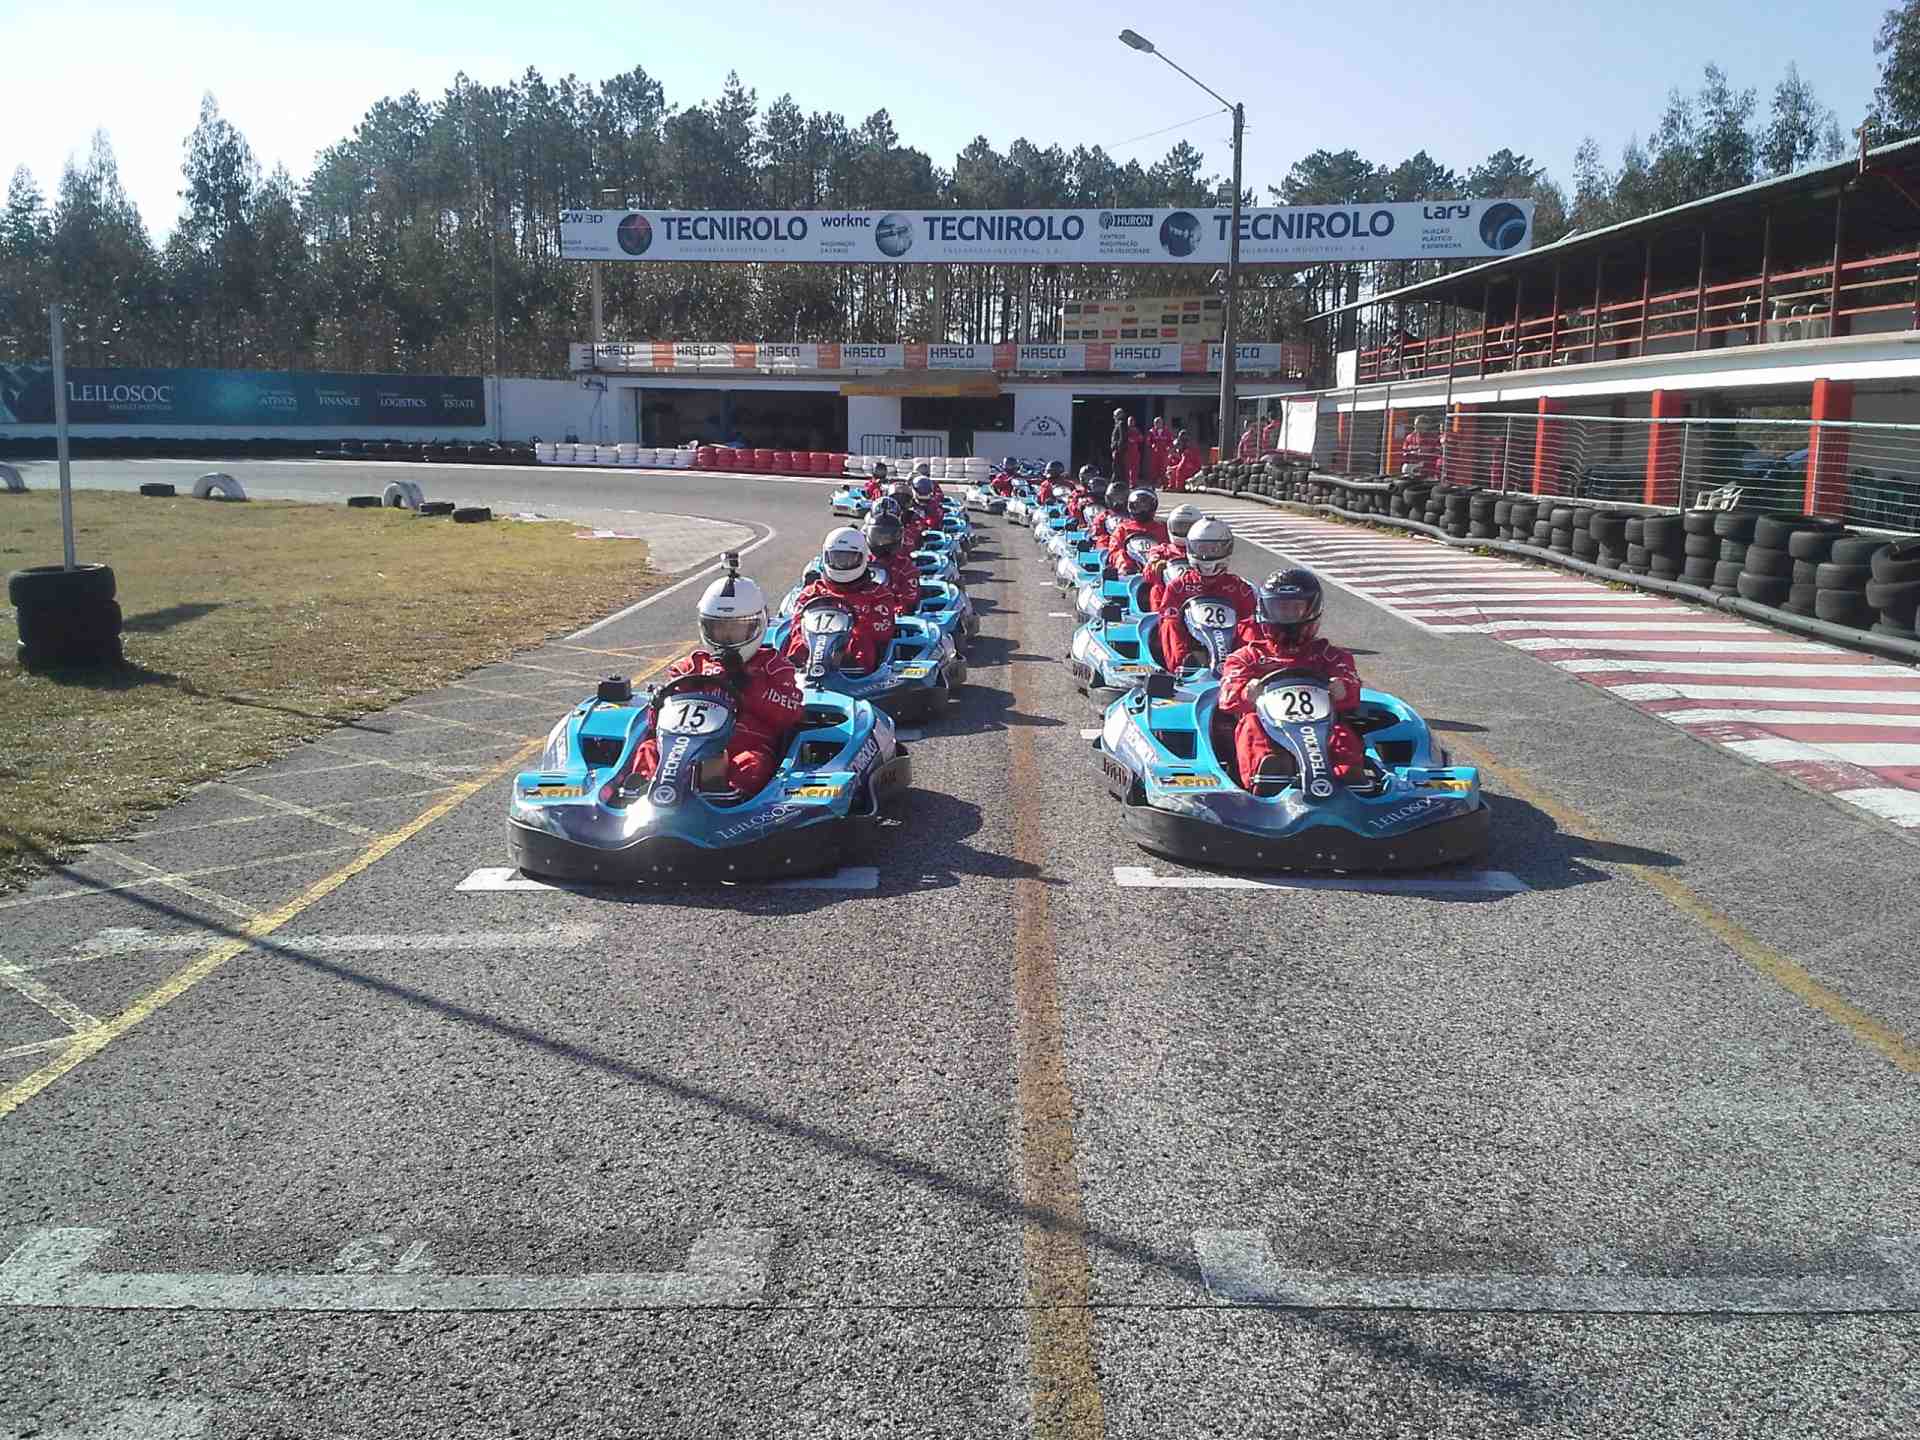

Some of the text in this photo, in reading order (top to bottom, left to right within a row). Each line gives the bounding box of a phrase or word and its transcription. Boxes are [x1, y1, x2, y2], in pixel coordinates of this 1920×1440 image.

[820, 213, 871, 228] worknc
[1116, 215, 1151, 226] HURON
[1213, 210, 1395, 241] TECNIROLO
[660, 216, 808, 241] TECNIROLO
[922, 215, 1085, 241] TECNIROLO
[594, 345, 636, 356] HASCO
[676, 345, 717, 357] HASCO
[758, 346, 800, 357] HASCO
[843, 347, 887, 359] HASCO
[930, 347, 975, 359] HASCO
[1021, 347, 1066, 359] HASCO
[1114, 347, 1161, 359] HASCO
[1211, 347, 1260, 359] HSCO
[66, 382, 170, 402] LEILOSOC
[1203, 606, 1226, 625] 26
[814, 613, 835, 632] 17
[1281, 691, 1314, 716] 28
[677, 704, 708, 728] 15
